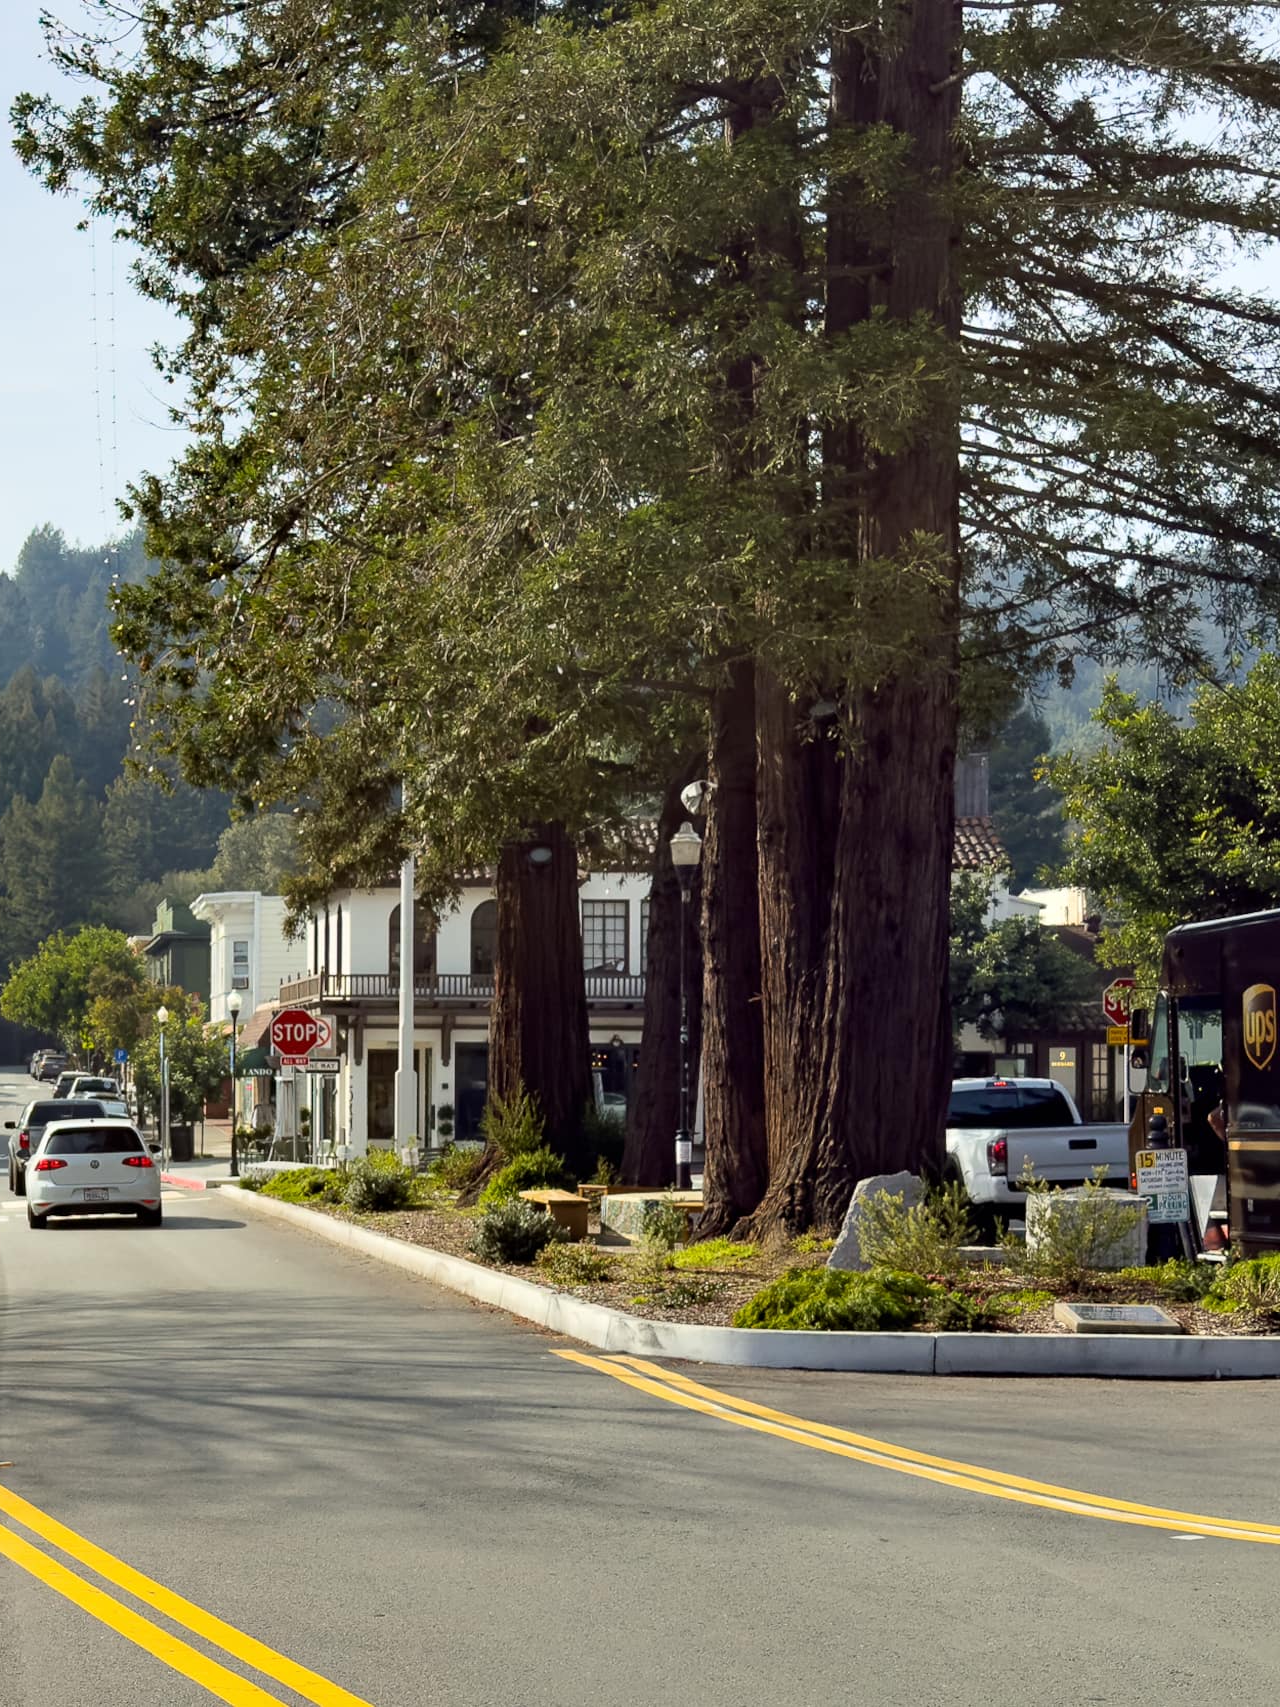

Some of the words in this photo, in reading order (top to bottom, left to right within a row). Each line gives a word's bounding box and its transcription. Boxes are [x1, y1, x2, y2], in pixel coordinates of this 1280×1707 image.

[273, 1023, 317, 1042] STOP
[1246, 1009, 1274, 1056] ups
[1059, 1051, 1066, 1061] 9
[1139, 1152, 1154, 1168] 15
[1156, 1151, 1185, 1161] MINUTE
[1159, 1200, 1187, 1210] PARKING
